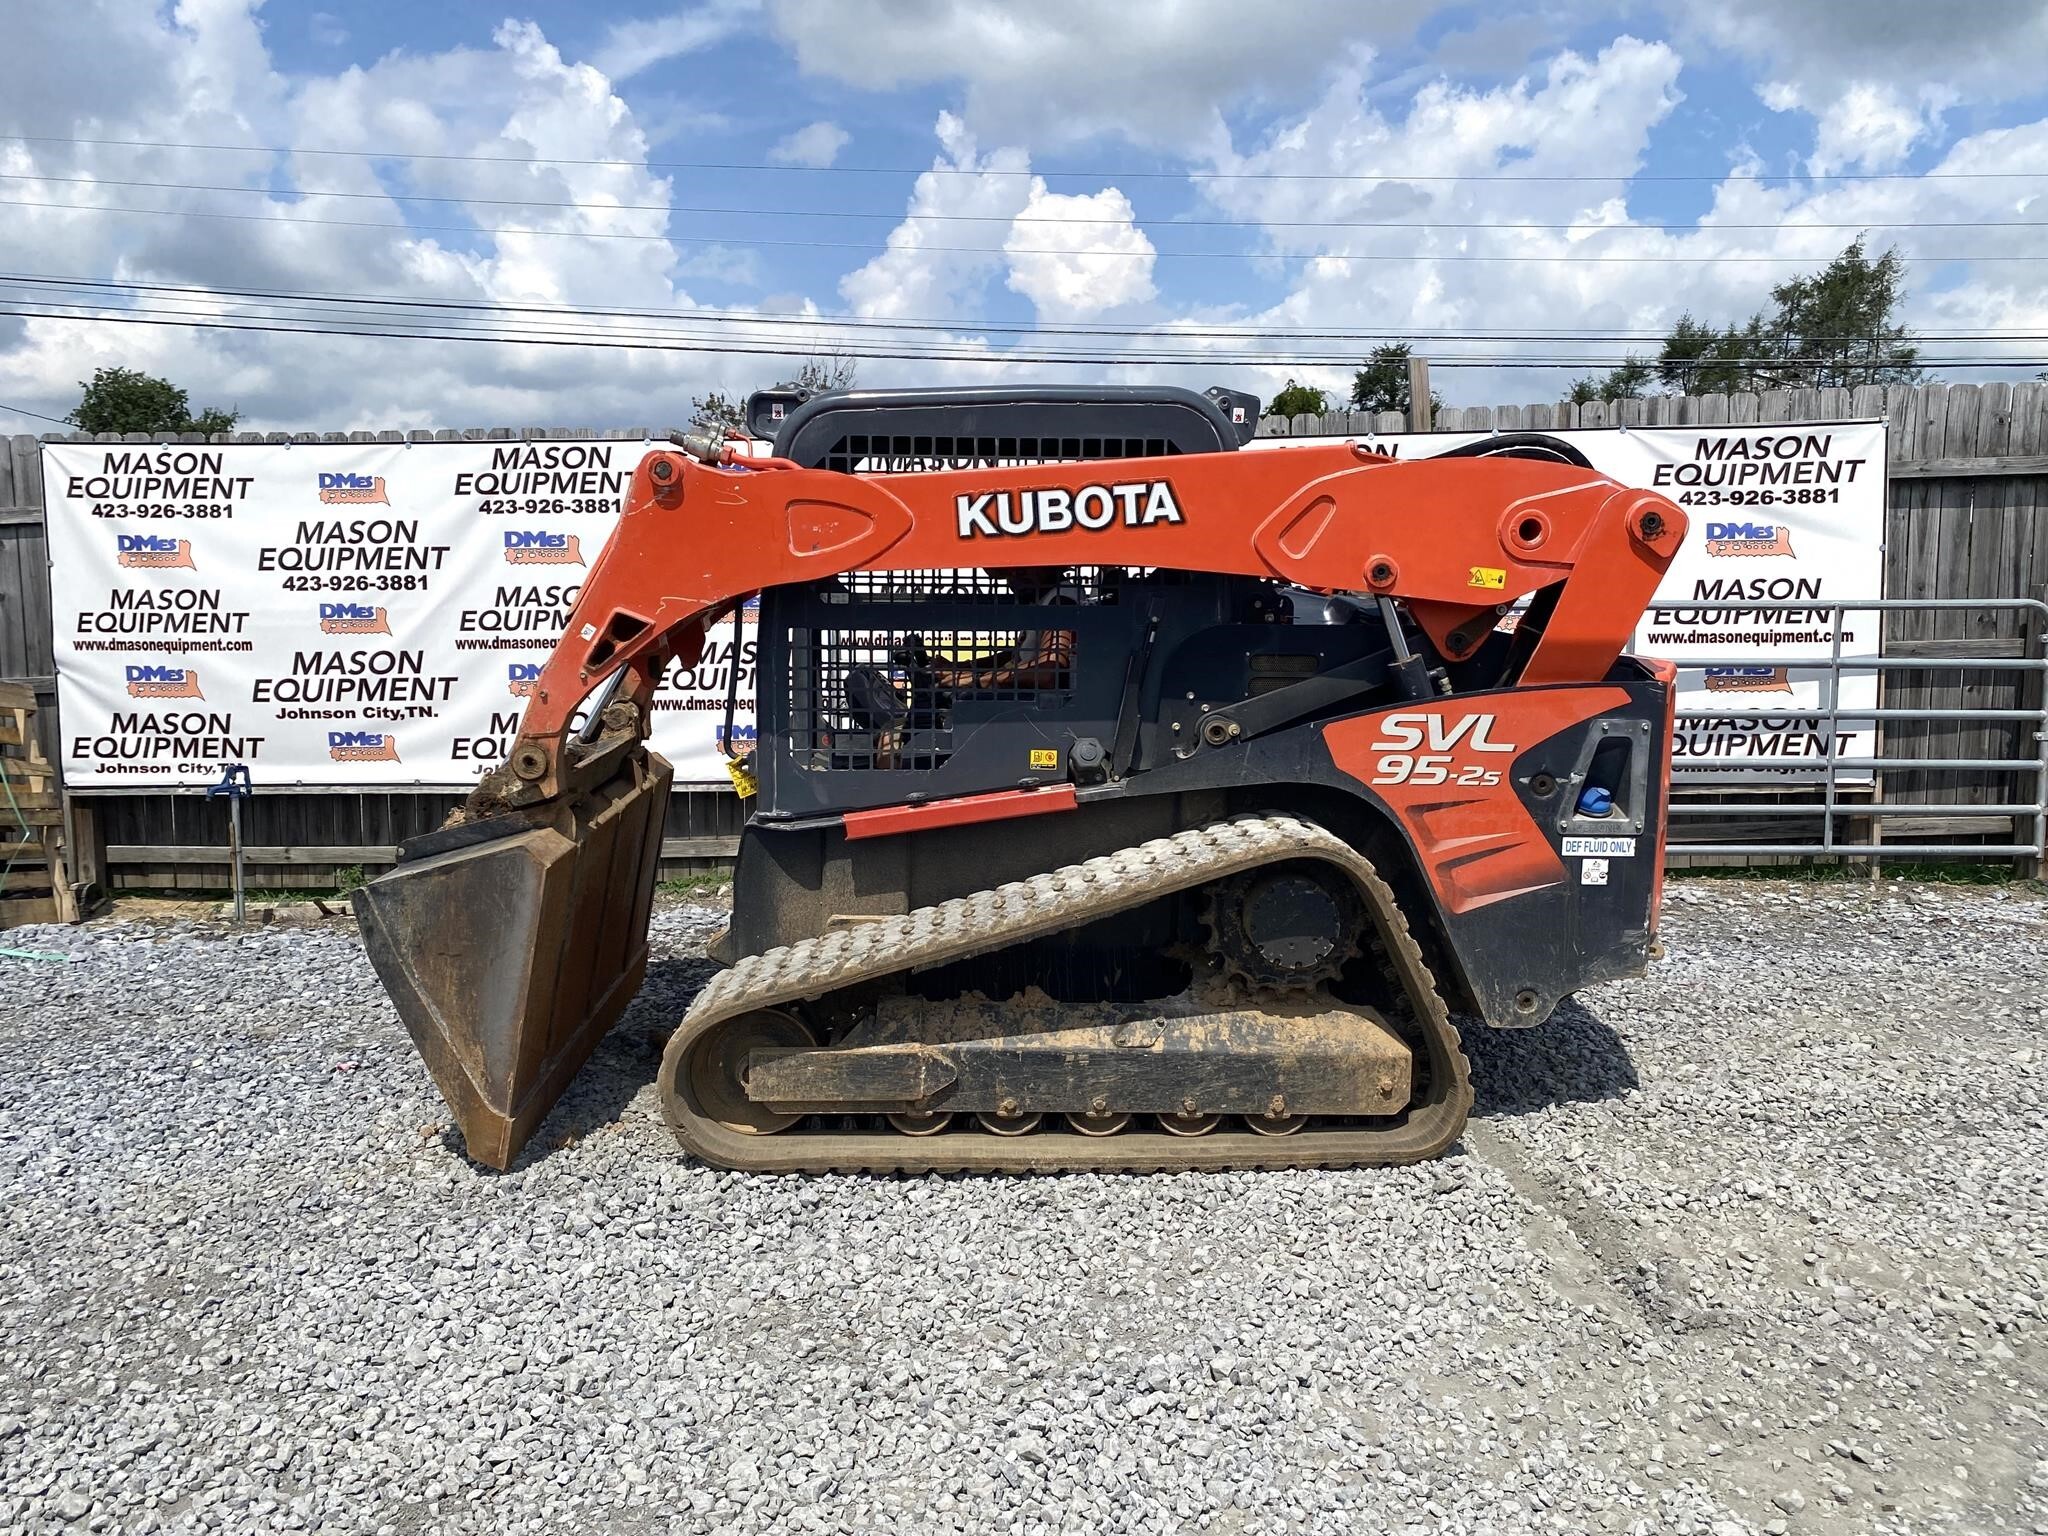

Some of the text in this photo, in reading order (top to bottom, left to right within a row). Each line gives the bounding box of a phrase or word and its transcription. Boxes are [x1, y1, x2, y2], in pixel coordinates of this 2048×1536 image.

[1695, 435, 1831, 460] MASON
[104, 453, 222, 474] MASON
[492, 447, 612, 470] MASON
[1653, 459, 1866, 486] EQUIPMENT
[67, 477, 254, 499] EQUIPMENT
[1679, 488, 1839, 505] 423-926-3881
[92, 504, 232, 518] 423-926-3881
[479, 499, 622, 515] 423-926-3881
[957, 481, 1184, 537] KUBOTA
[296, 520, 418, 544] MASON
[258, 547, 450, 571] EQUIPMENT
[283, 575, 427, 591] 423-926-3881
[1693, 578, 1821, 600] MASON
[111, 589, 220, 610] MASON
[495, 586, 581, 607] MASO
[78, 612, 249, 633] EQUIPMENT
[73, 638, 252, 654] www.dmasonequipment.com
[1648, 629, 1854, 647] www.dmasonequipment.cm
[293, 651, 423, 675] MASON
[253, 677, 458, 702] EQUIPMENT
[111, 713, 231, 735] MASON
[276, 706, 438, 721] Johnson City,TN.
[1369, 713, 1517, 753] SVL
[72, 737, 265, 758] EQUIPMENT
[95, 763, 171, 773] Johnson
[1565, 840, 1633, 853] DEF FLUID ONLY
